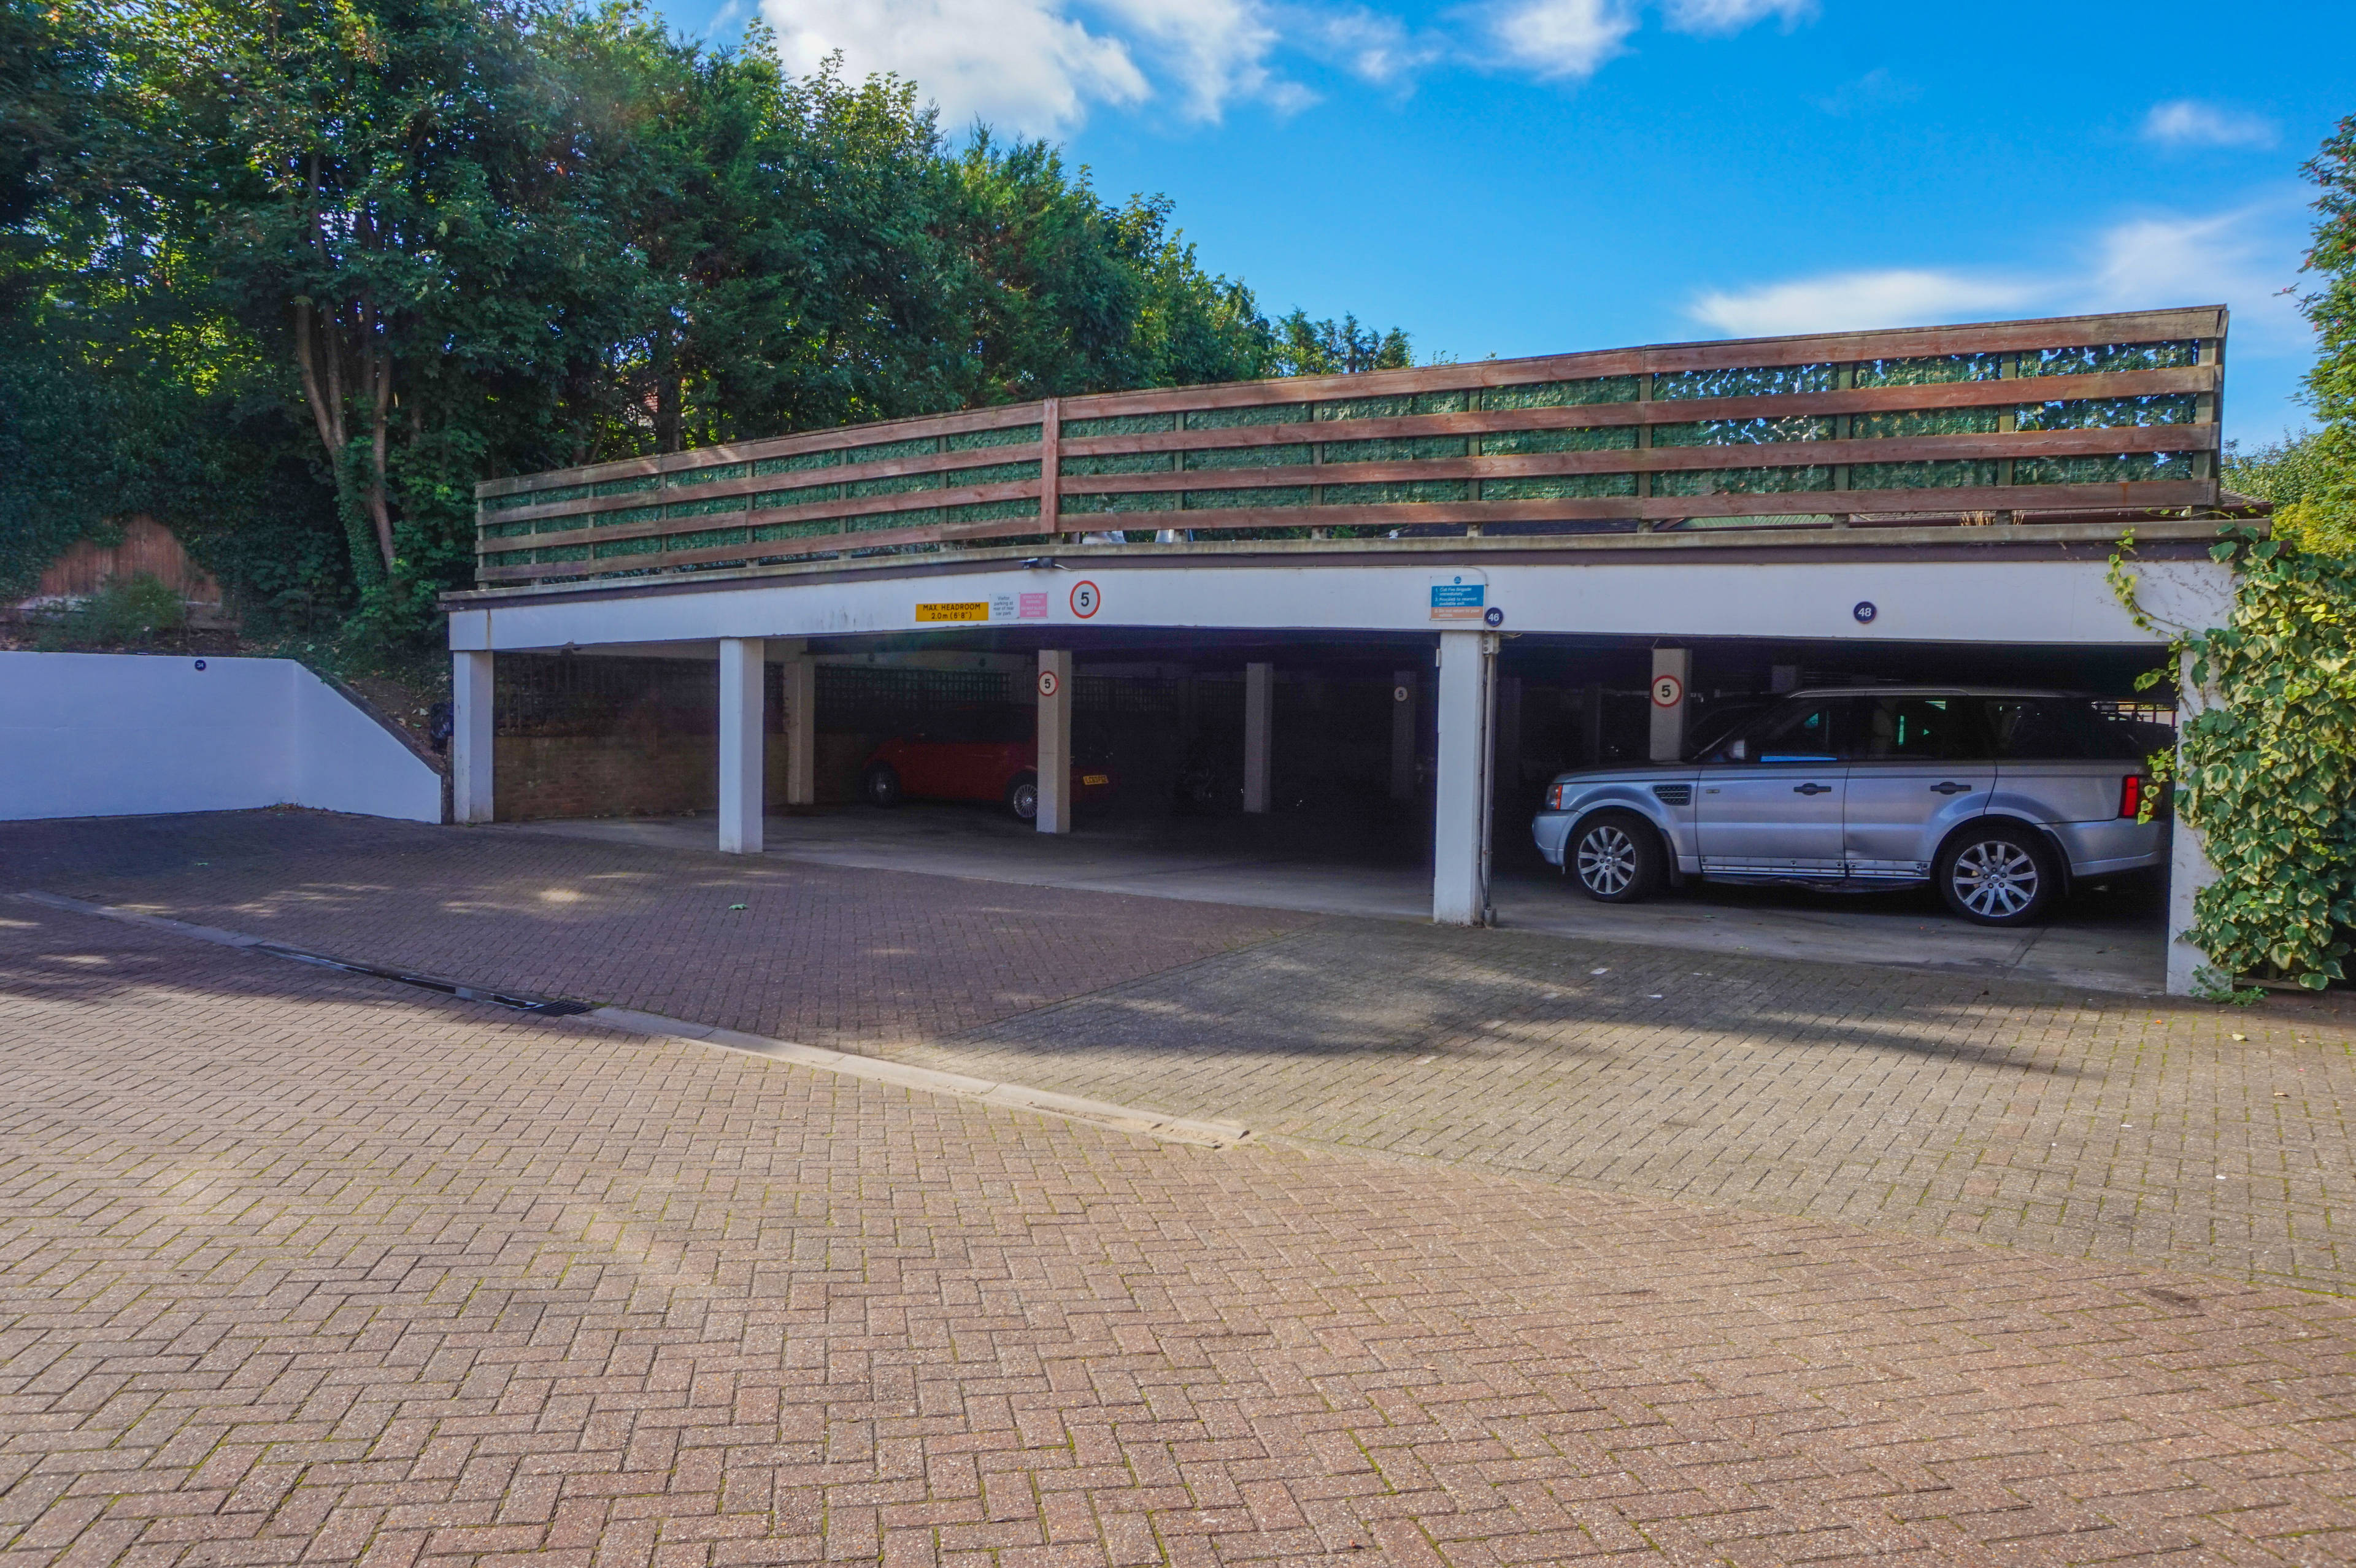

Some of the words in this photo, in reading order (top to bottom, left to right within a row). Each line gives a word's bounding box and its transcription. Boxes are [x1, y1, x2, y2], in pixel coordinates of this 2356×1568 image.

[1081, 592, 1089, 607] 5
[1858, 607, 1871, 617] 48
[1045, 678, 1051, 689] 5
[1662, 685, 1671, 698] 5
